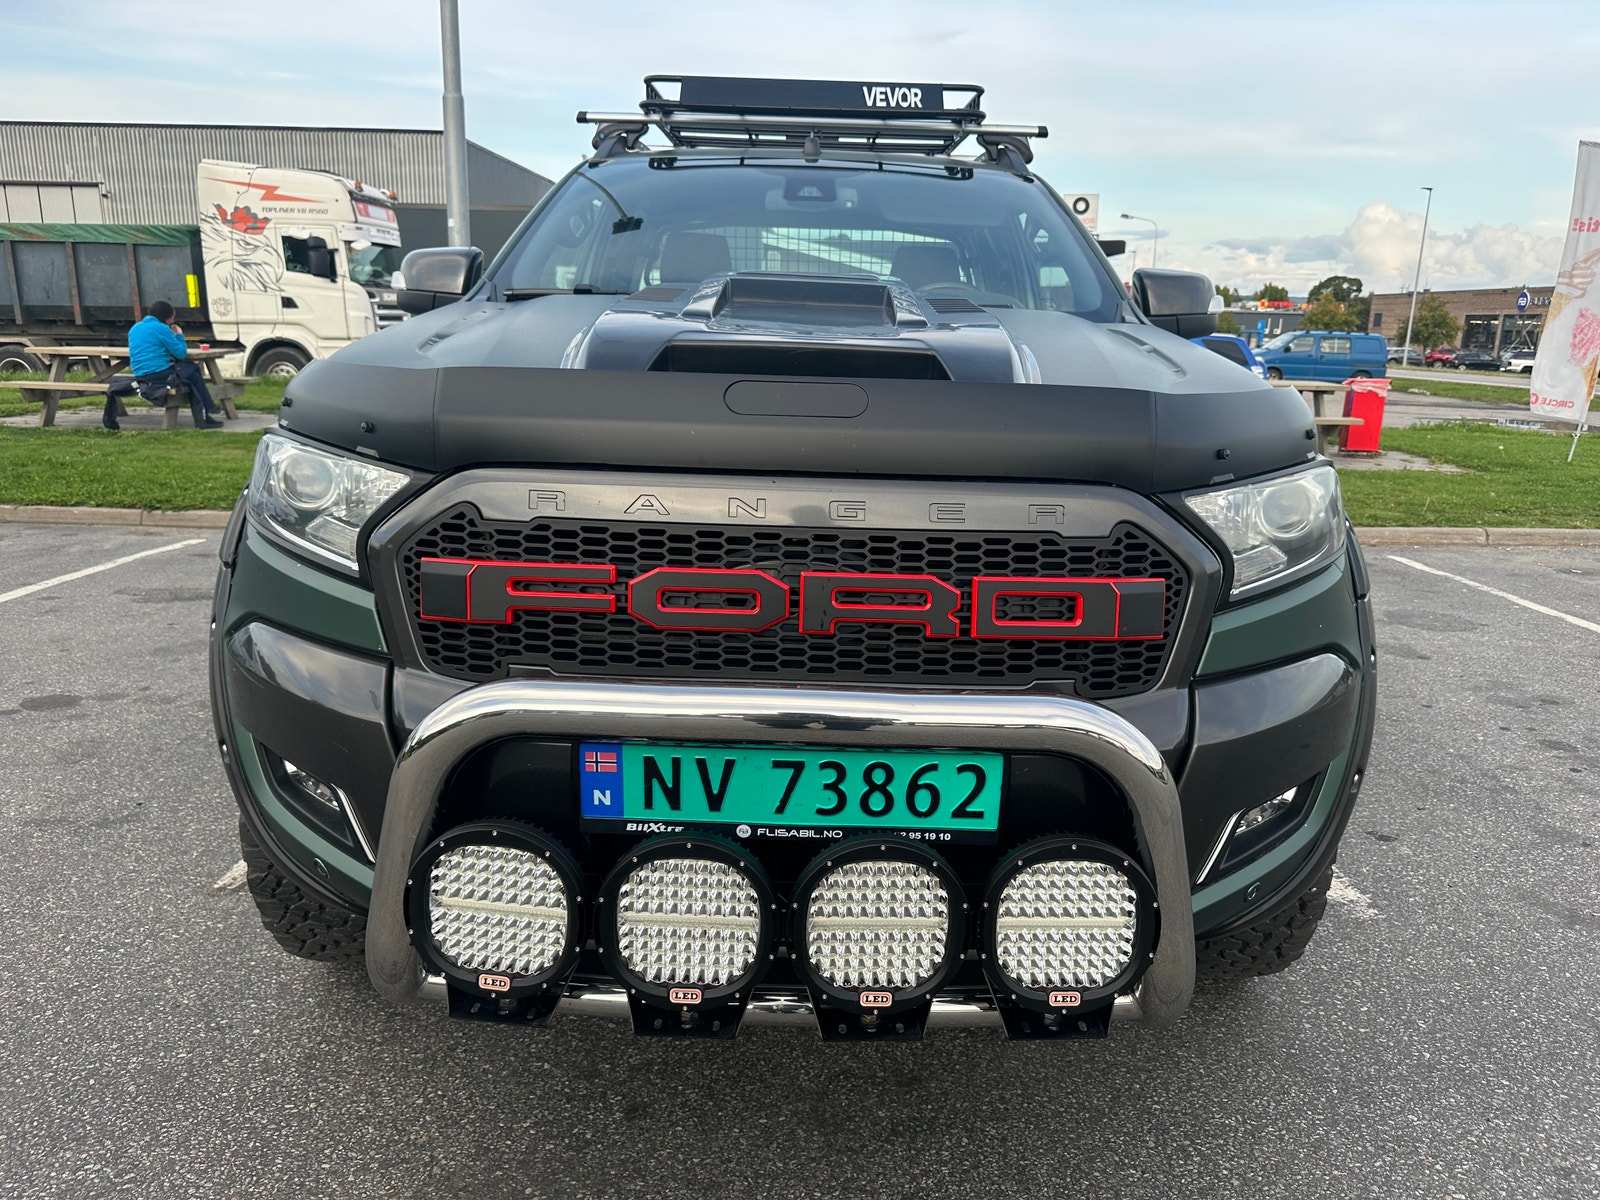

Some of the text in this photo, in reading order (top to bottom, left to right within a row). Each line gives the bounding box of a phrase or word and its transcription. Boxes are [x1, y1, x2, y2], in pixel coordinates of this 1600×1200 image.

[862, 85, 923, 108] VEVOR
[528, 489, 1067, 526] RANGER
[419, 557, 1166, 641] FORD
[593, 754, 987, 819] N NV 73862
[757, 828, 843, 838] FLISABIL.NO
[908, 831, 922, 840] 95
[923, 832, 937, 841] 19
[938, 833, 951, 841] 10
[482, 977, 507, 988] LED
[674, 991, 699, 1000] LED
[864, 995, 889, 1003] LED
[1053, 995, 1078, 1003] LED
